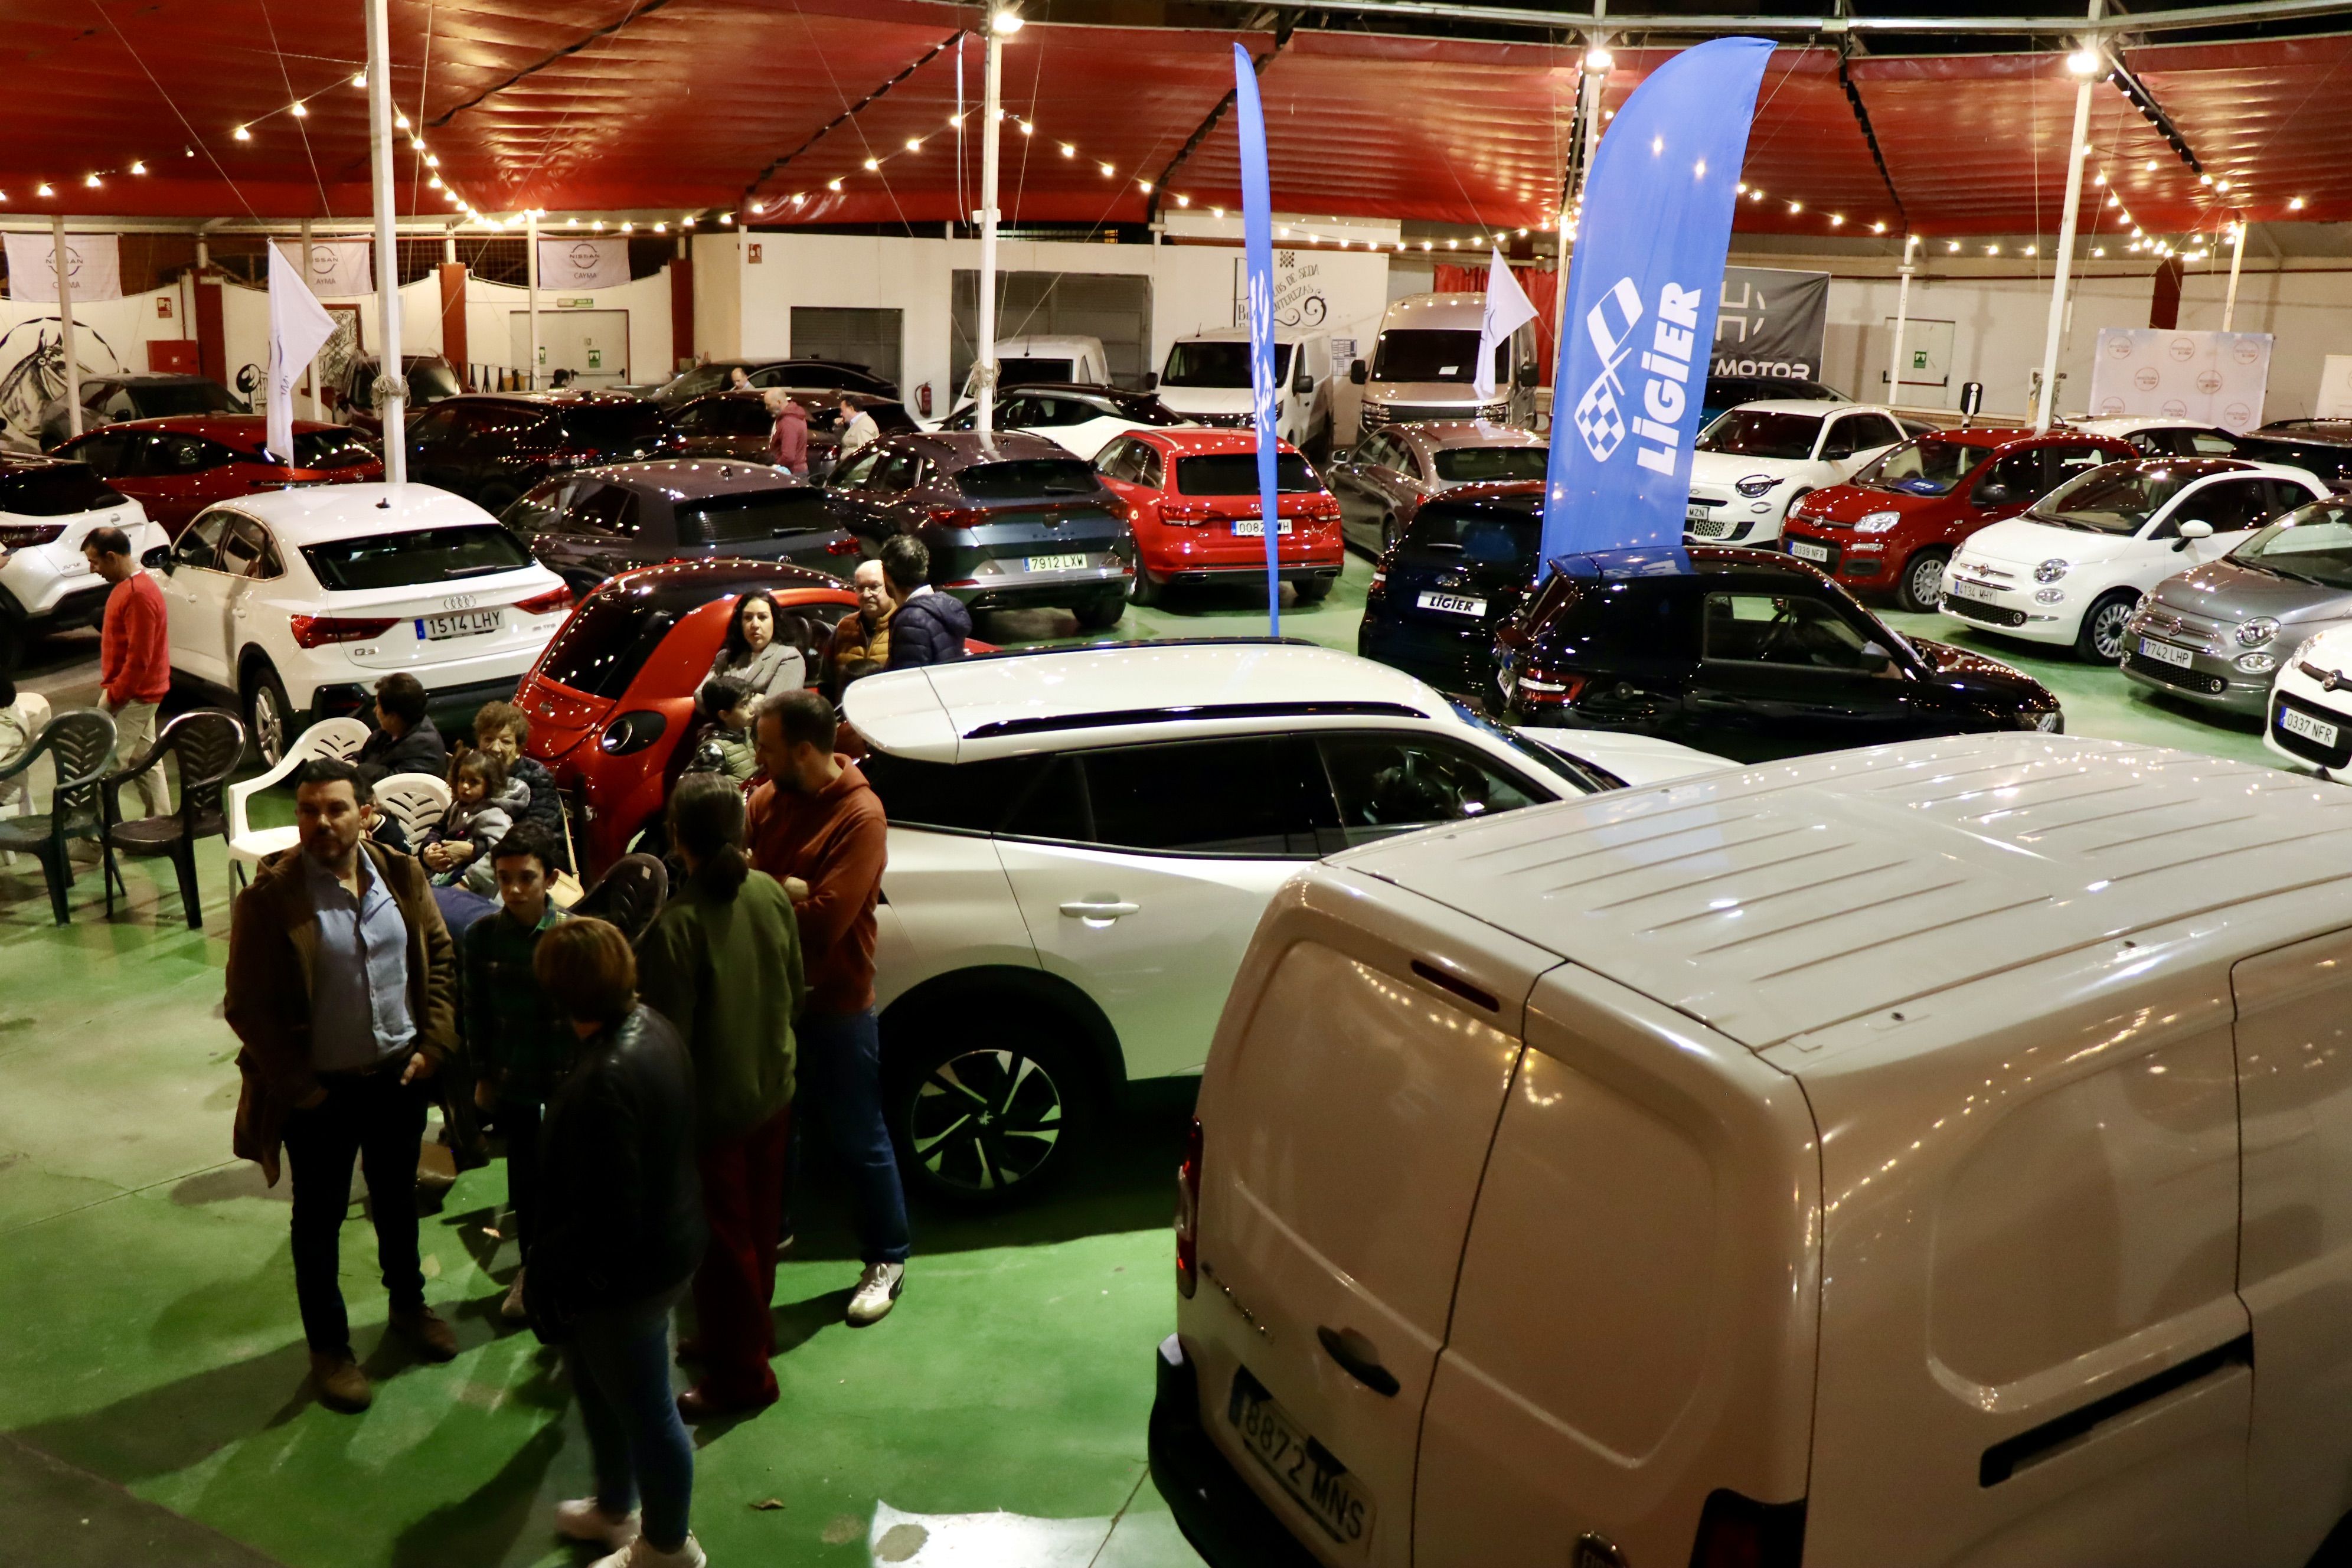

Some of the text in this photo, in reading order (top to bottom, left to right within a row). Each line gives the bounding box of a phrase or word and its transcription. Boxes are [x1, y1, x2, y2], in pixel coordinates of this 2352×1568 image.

[1286, 273, 1297, 286] DE
[1714, 358, 1810, 380] MOTOR
[1689, 508, 1704, 517] MZN
[1794, 543, 1824, 559] 0339 NFR
[1032, 555, 1083, 570] 7912 LXW
[1959, 584, 1993, 602] 4134 MHY
[429, 610, 499, 635] 1514 LHY
[2146, 642, 2188, 665] 7742 LHP
[2287, 713, 2332, 743] 0337 NFR
[1245, 1400, 1364, 1540] 8872 MNS
